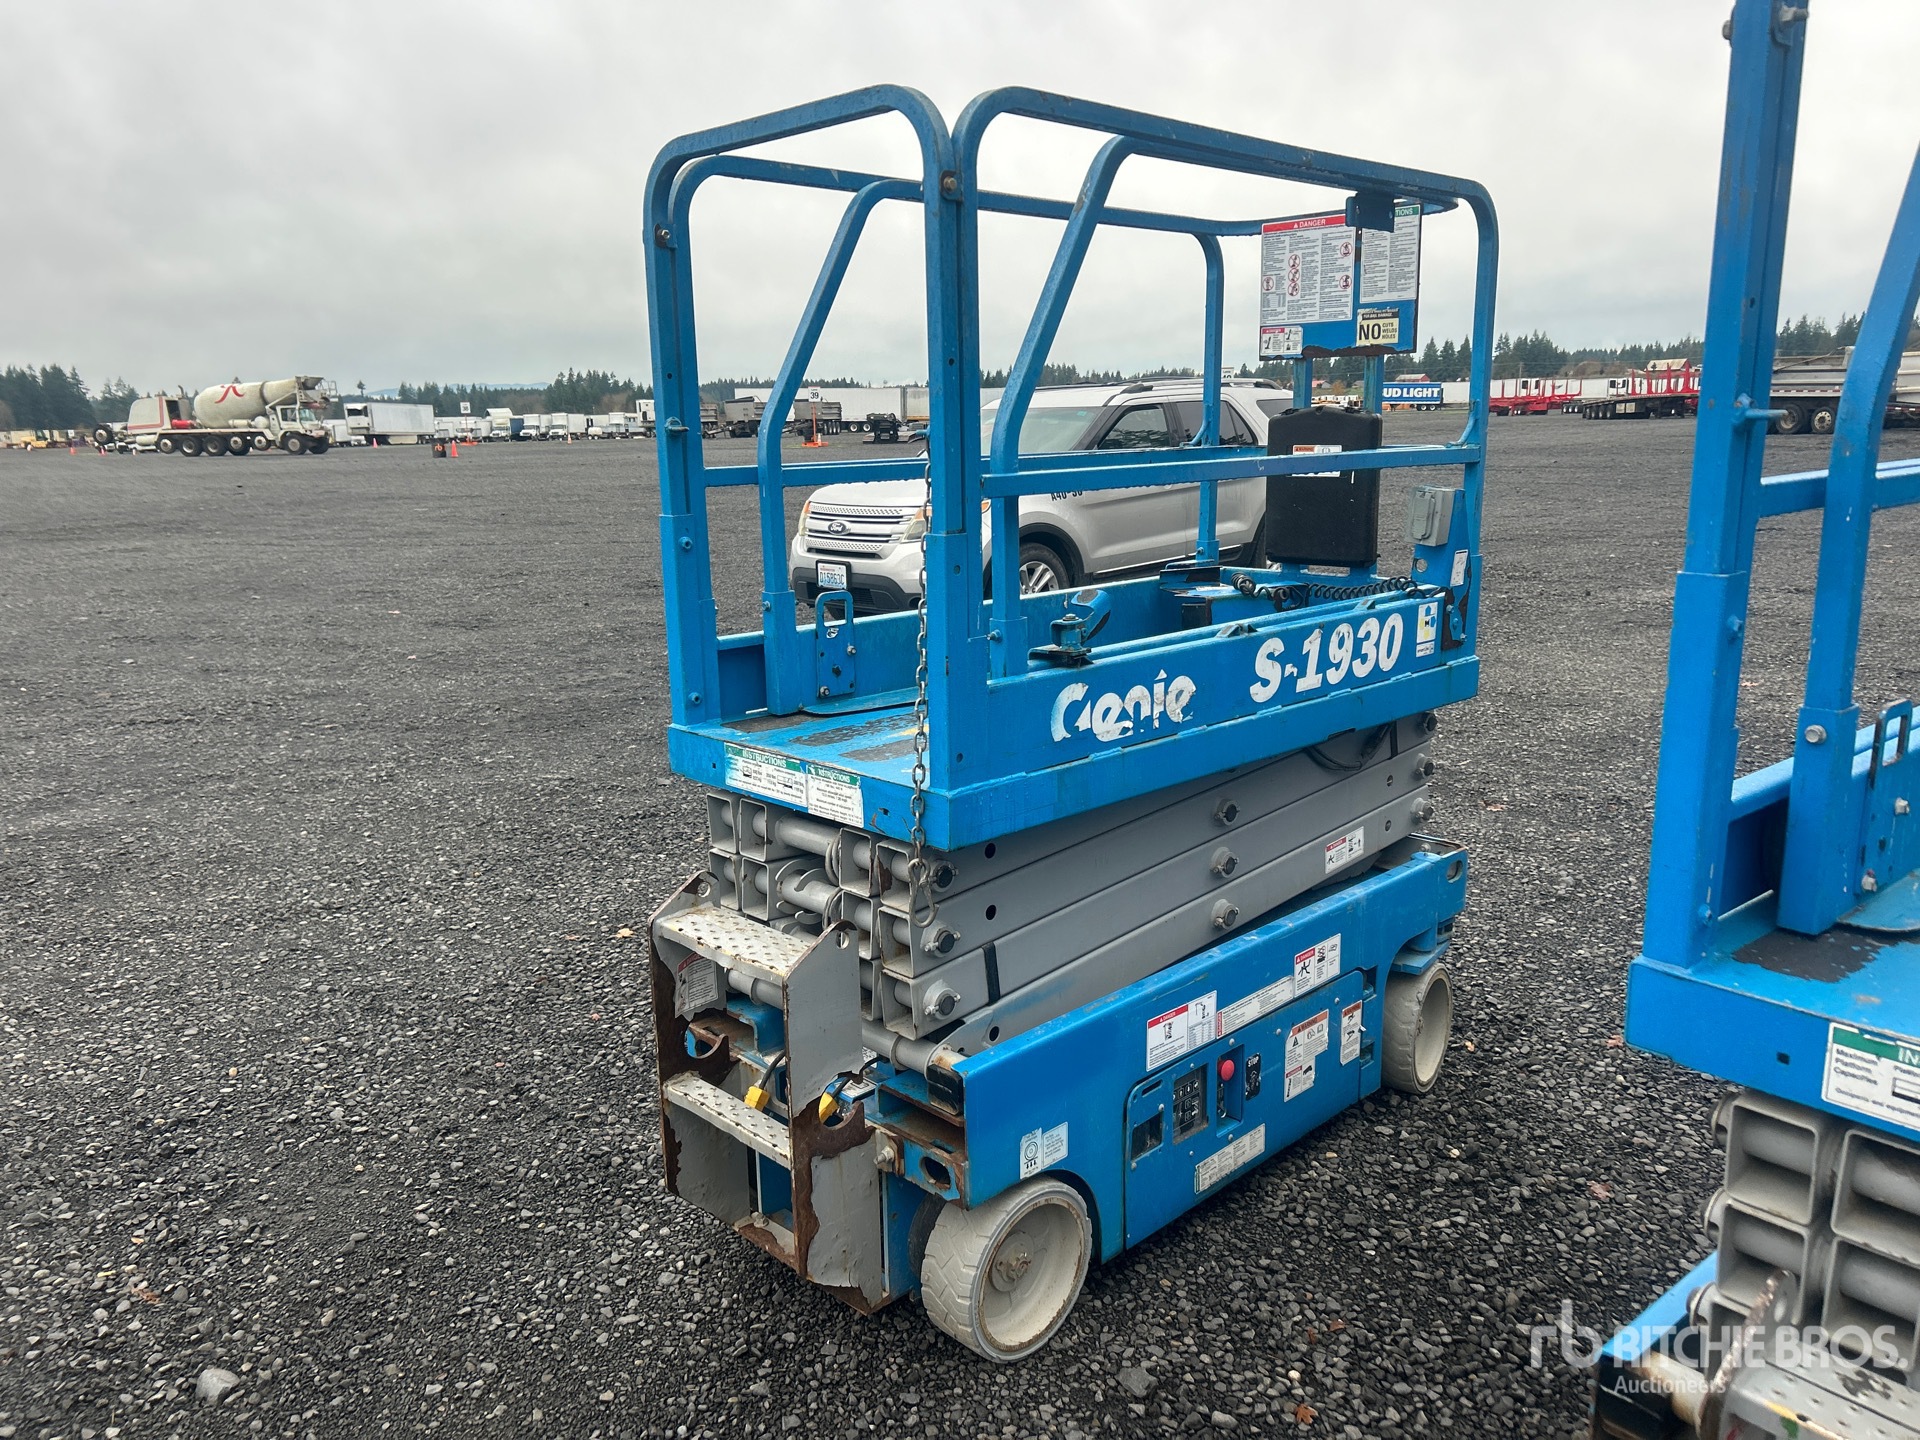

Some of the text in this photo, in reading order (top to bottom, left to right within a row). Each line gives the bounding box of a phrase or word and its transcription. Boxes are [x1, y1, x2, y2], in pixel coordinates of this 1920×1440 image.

[1299, 218, 1326, 228] DANGER
[1359, 323, 1381, 341] NO
[810, 391, 819, 400] 39
[1382, 387, 1440, 398] UD LIGHT
[830, 521, 844, 531] Ford
[1250, 613, 1404, 703] S-1930
[1051, 669, 1197, 742] Genie
[742, 749, 787, 768] INSTRUCTIONS
[817, 768, 851, 783] NSTRUCTIONS
[1162, 1011, 1176, 1020] DANGER
[1247, 1055, 1259, 1067] STOP
[1898, 1046, 1920, 1066] IN
